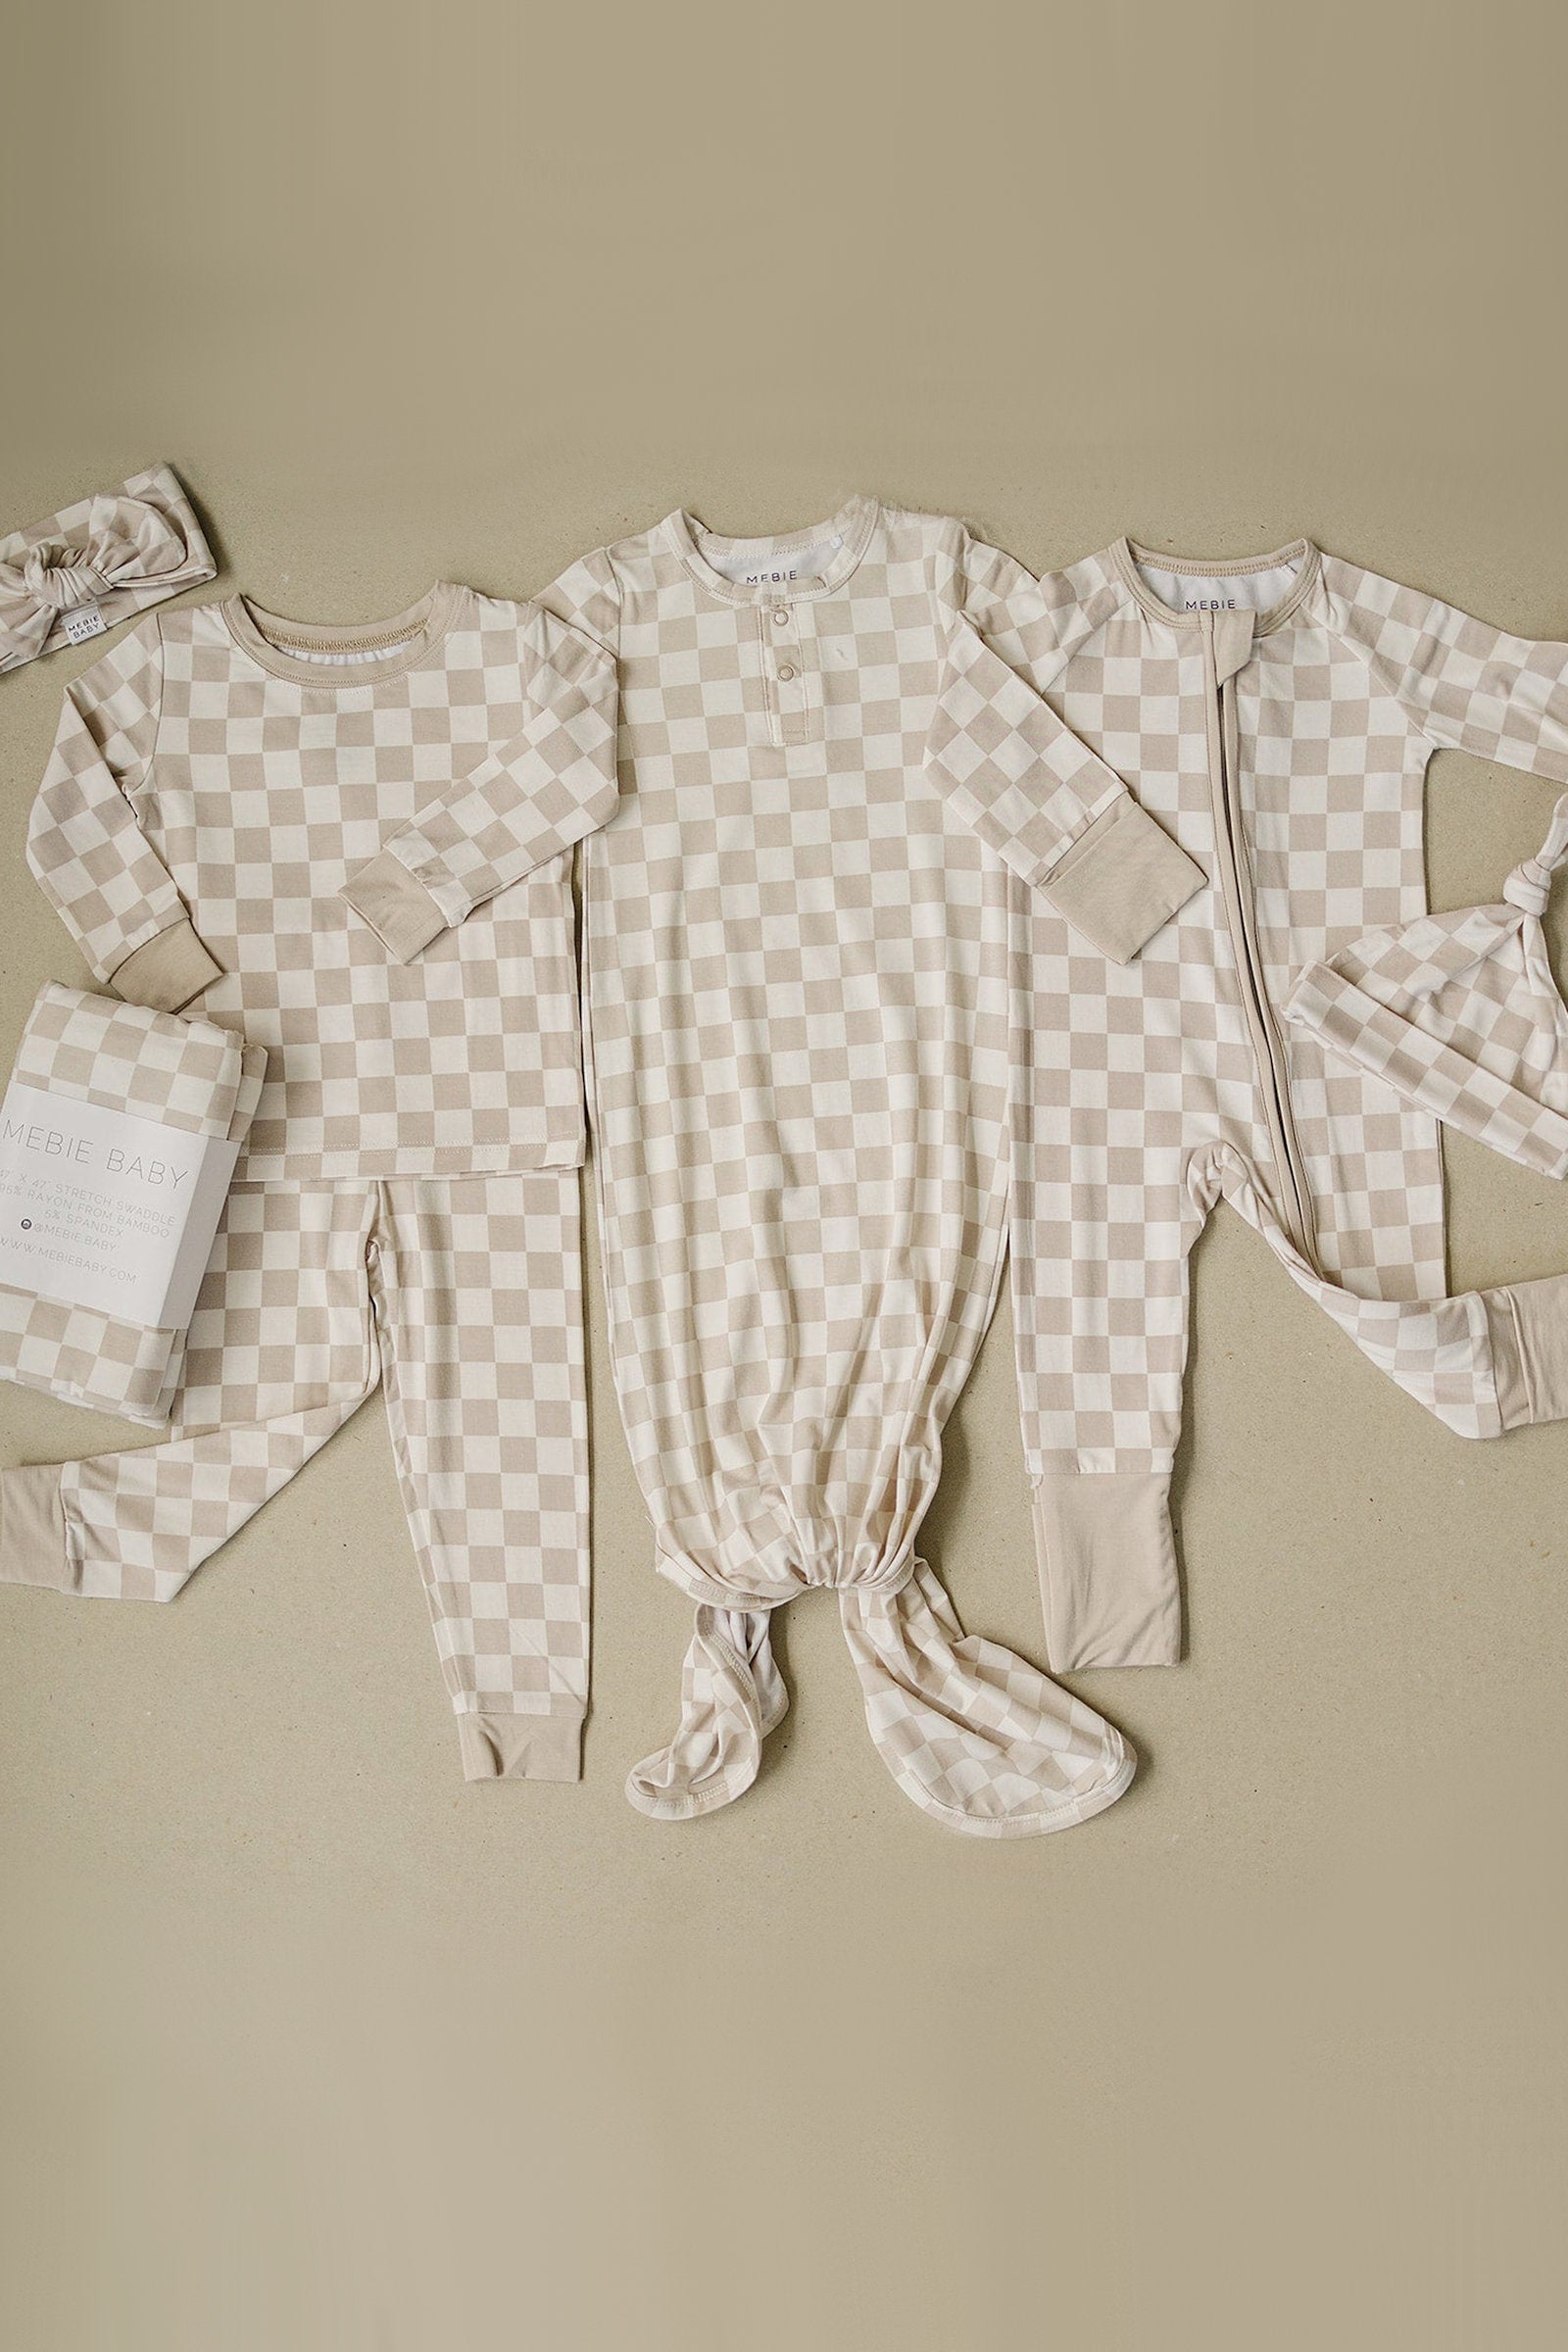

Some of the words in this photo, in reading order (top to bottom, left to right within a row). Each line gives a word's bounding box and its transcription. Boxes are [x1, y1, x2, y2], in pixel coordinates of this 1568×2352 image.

[746, 570, 798, 584] MEBIE
[1185, 599, 1236, 610] MEBIE
[69, 614, 99, 632] MEBIE
[73, 622, 99, 639] BABY
[3, 1119, 94, 1164] MEBIE
[106, 1148, 188, 1189] BABY
[27, 1189, 73, 1209] RAYON
[77, 1202, 113, 1221] FROM
[117, 1214, 171, 1238] BAMBOO
[56, 1183, 112, 1207] STRETCH
[117, 1200, 175, 1226] SWADDLE
[66, 1213, 124, 1239] SPANDEX
